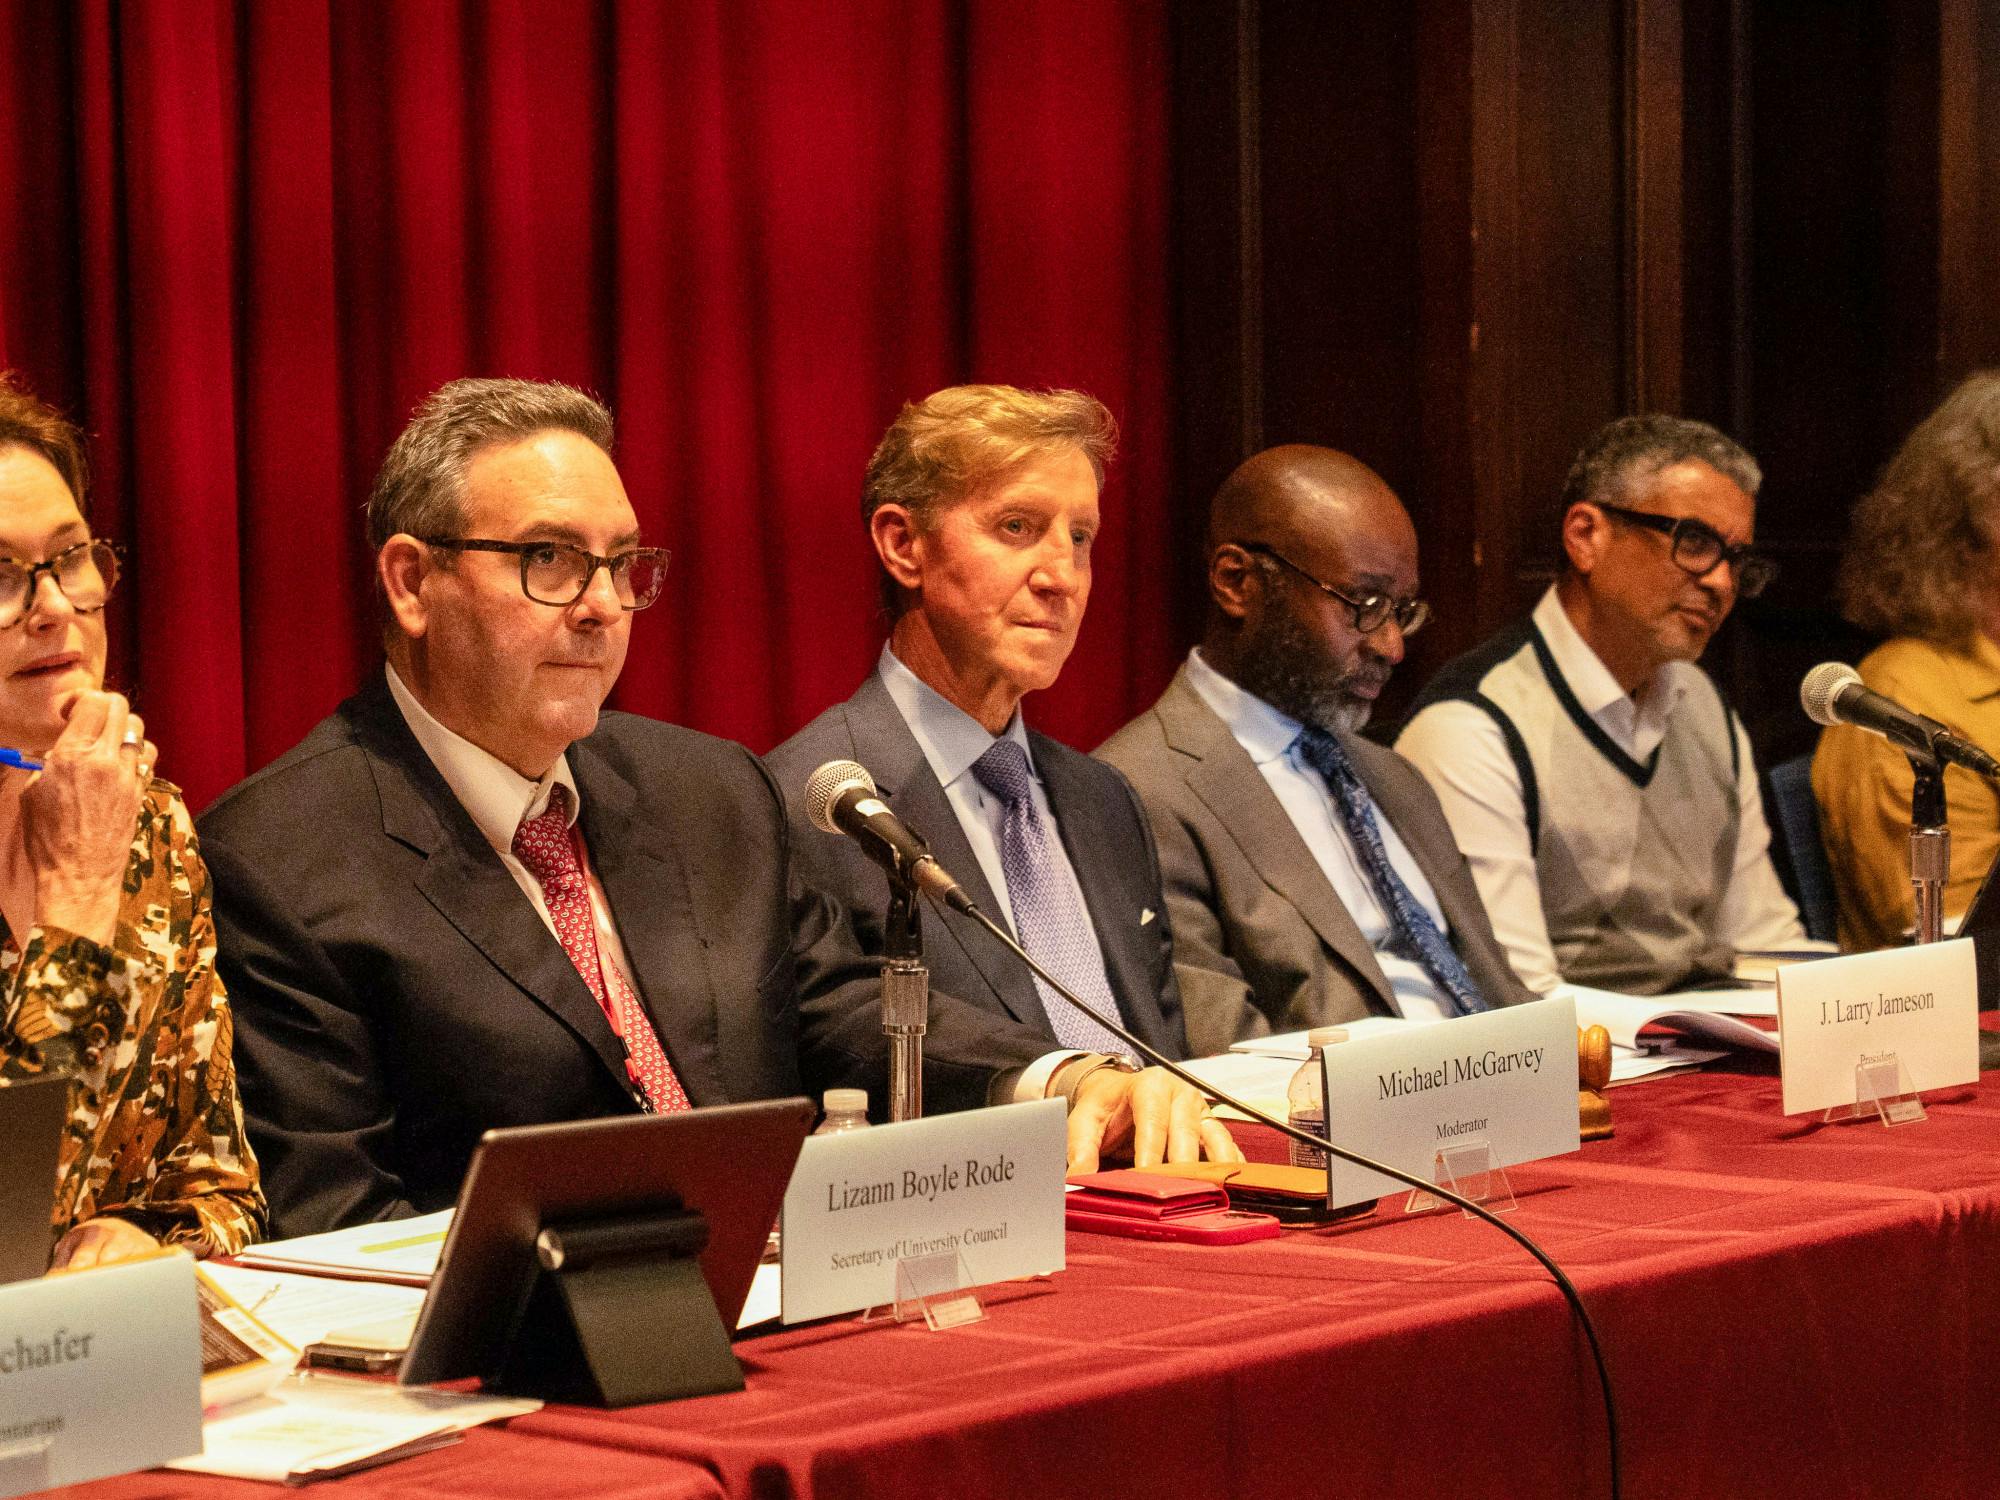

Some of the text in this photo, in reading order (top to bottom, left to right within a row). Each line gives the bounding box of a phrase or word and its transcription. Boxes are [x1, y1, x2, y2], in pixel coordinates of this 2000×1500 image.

[1820, 992, 1934, 1025] J. Larry Jameson
[1378, 1048, 1544, 1100] Michael McGarvey
[1435, 1117, 1489, 1140] Moderator
[828, 1154, 1015, 1212] Lizann Boyle Rode
[830, 1222, 1008, 1271] Secretary of University Council
